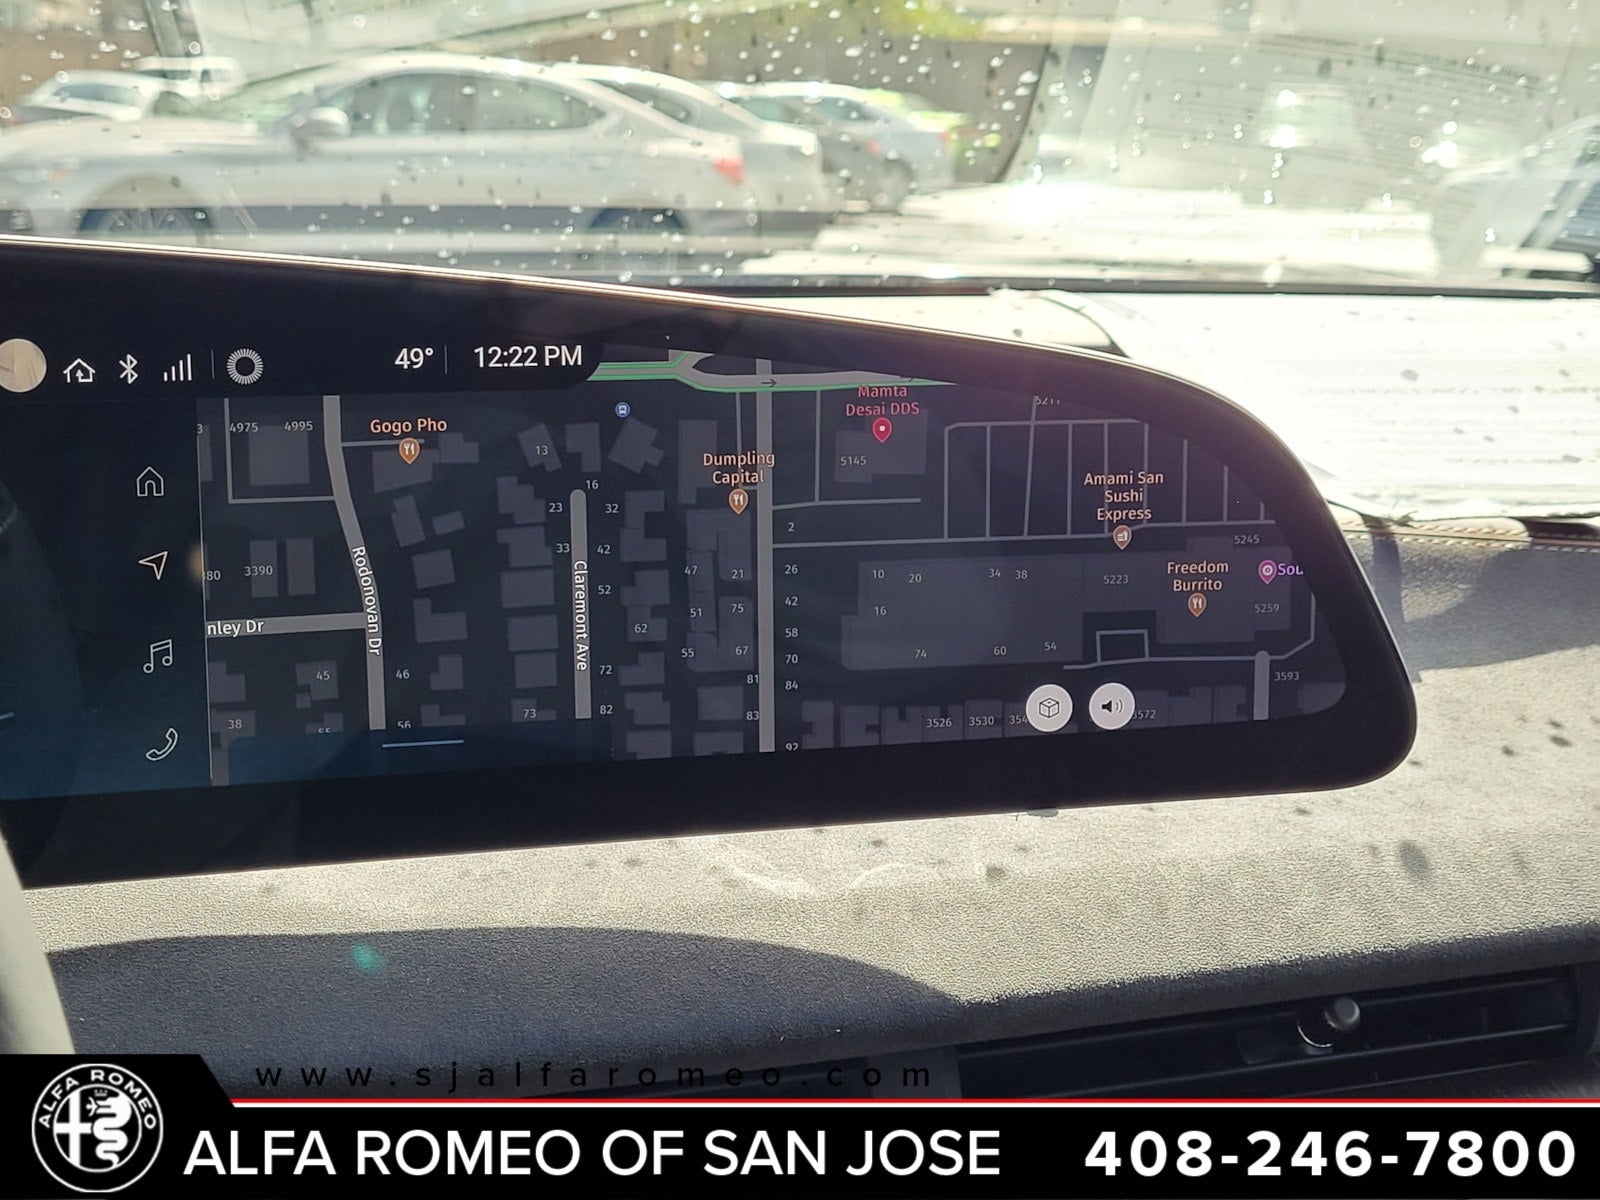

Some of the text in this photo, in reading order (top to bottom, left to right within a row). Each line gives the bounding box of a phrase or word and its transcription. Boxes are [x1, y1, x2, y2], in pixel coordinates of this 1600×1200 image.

[395, 347, 434, 369] 49°
[474, 345, 582, 369] 12:22 PM
[858, 385, 907, 398] Mamta
[846, 402, 920, 417] Desai DDS
[229, 422, 259, 433] 4975
[284, 420, 313, 432] 4995
[369, 418, 447, 436] Gogo Pho
[535, 446, 548, 456] 13
[703, 452, 775, 467] Dumpling
[840, 456, 867, 466] 5145
[712, 469, 764, 485] Capital
[1084, 471, 1164, 485] Amami San
[585, 479, 599, 490] 16
[1105, 489, 1144, 502] Sushi
[549, 503, 563, 513] 23
[605, 503, 619, 514] 32
[1097, 507, 1152, 522] Express
[788, 522, 795, 532] 2
[1234, 534, 1260, 545] 5245
[556, 543, 570, 553] 33
[597, 545, 611, 556] 42
[244, 565, 273, 576] 3390
[685, 565, 698, 575] 47
[785, 565, 798, 575] 26
[989, 568, 1001, 578] 34
[1167, 561, 1229, 575] Freedom
[731, 569, 744, 579] 21
[872, 570, 885, 580] 10
[908, 573, 922, 583] 20
[1014, 569, 1028, 580] 38
[1104, 574, 1129, 585] 5223
[598, 584, 611, 595] 52
[1173, 578, 1222, 591] Burrito
[351, 546, 383, 656] Rodonovan Dr
[785, 596, 798, 607] 42
[690, 608, 702, 618] 51
[731, 604, 744, 614] 75
[873, 606, 887, 616] 16
[1254, 603, 1280, 614] 5259
[574, 561, 589, 671] Claremont Ave
[207, 619, 264, 637] nley Dr
[634, 623, 648, 634] 62
[785, 628, 798, 638] 58
[735, 645, 748, 655] 67
[994, 646, 1007, 656] 60
[1044, 641, 1057, 652] 54
[681, 648, 694, 658] 55
[914, 649, 927, 659] 74
[785, 654, 798, 664] 70
[316, 670, 330, 681] 45
[396, 669, 410, 679] 46
[600, 665, 613, 675] 72
[747, 674, 759, 684] 81
[1274, 671, 1300, 682] 3593
[785, 680, 798, 690] 84
[523, 708, 536, 718] 73
[600, 704, 613, 715] 82
[746, 711, 759, 721] 83
[969, 716, 995, 727] 3530
[228, 718, 242, 730] 38
[926, 718, 952, 728] 3526
